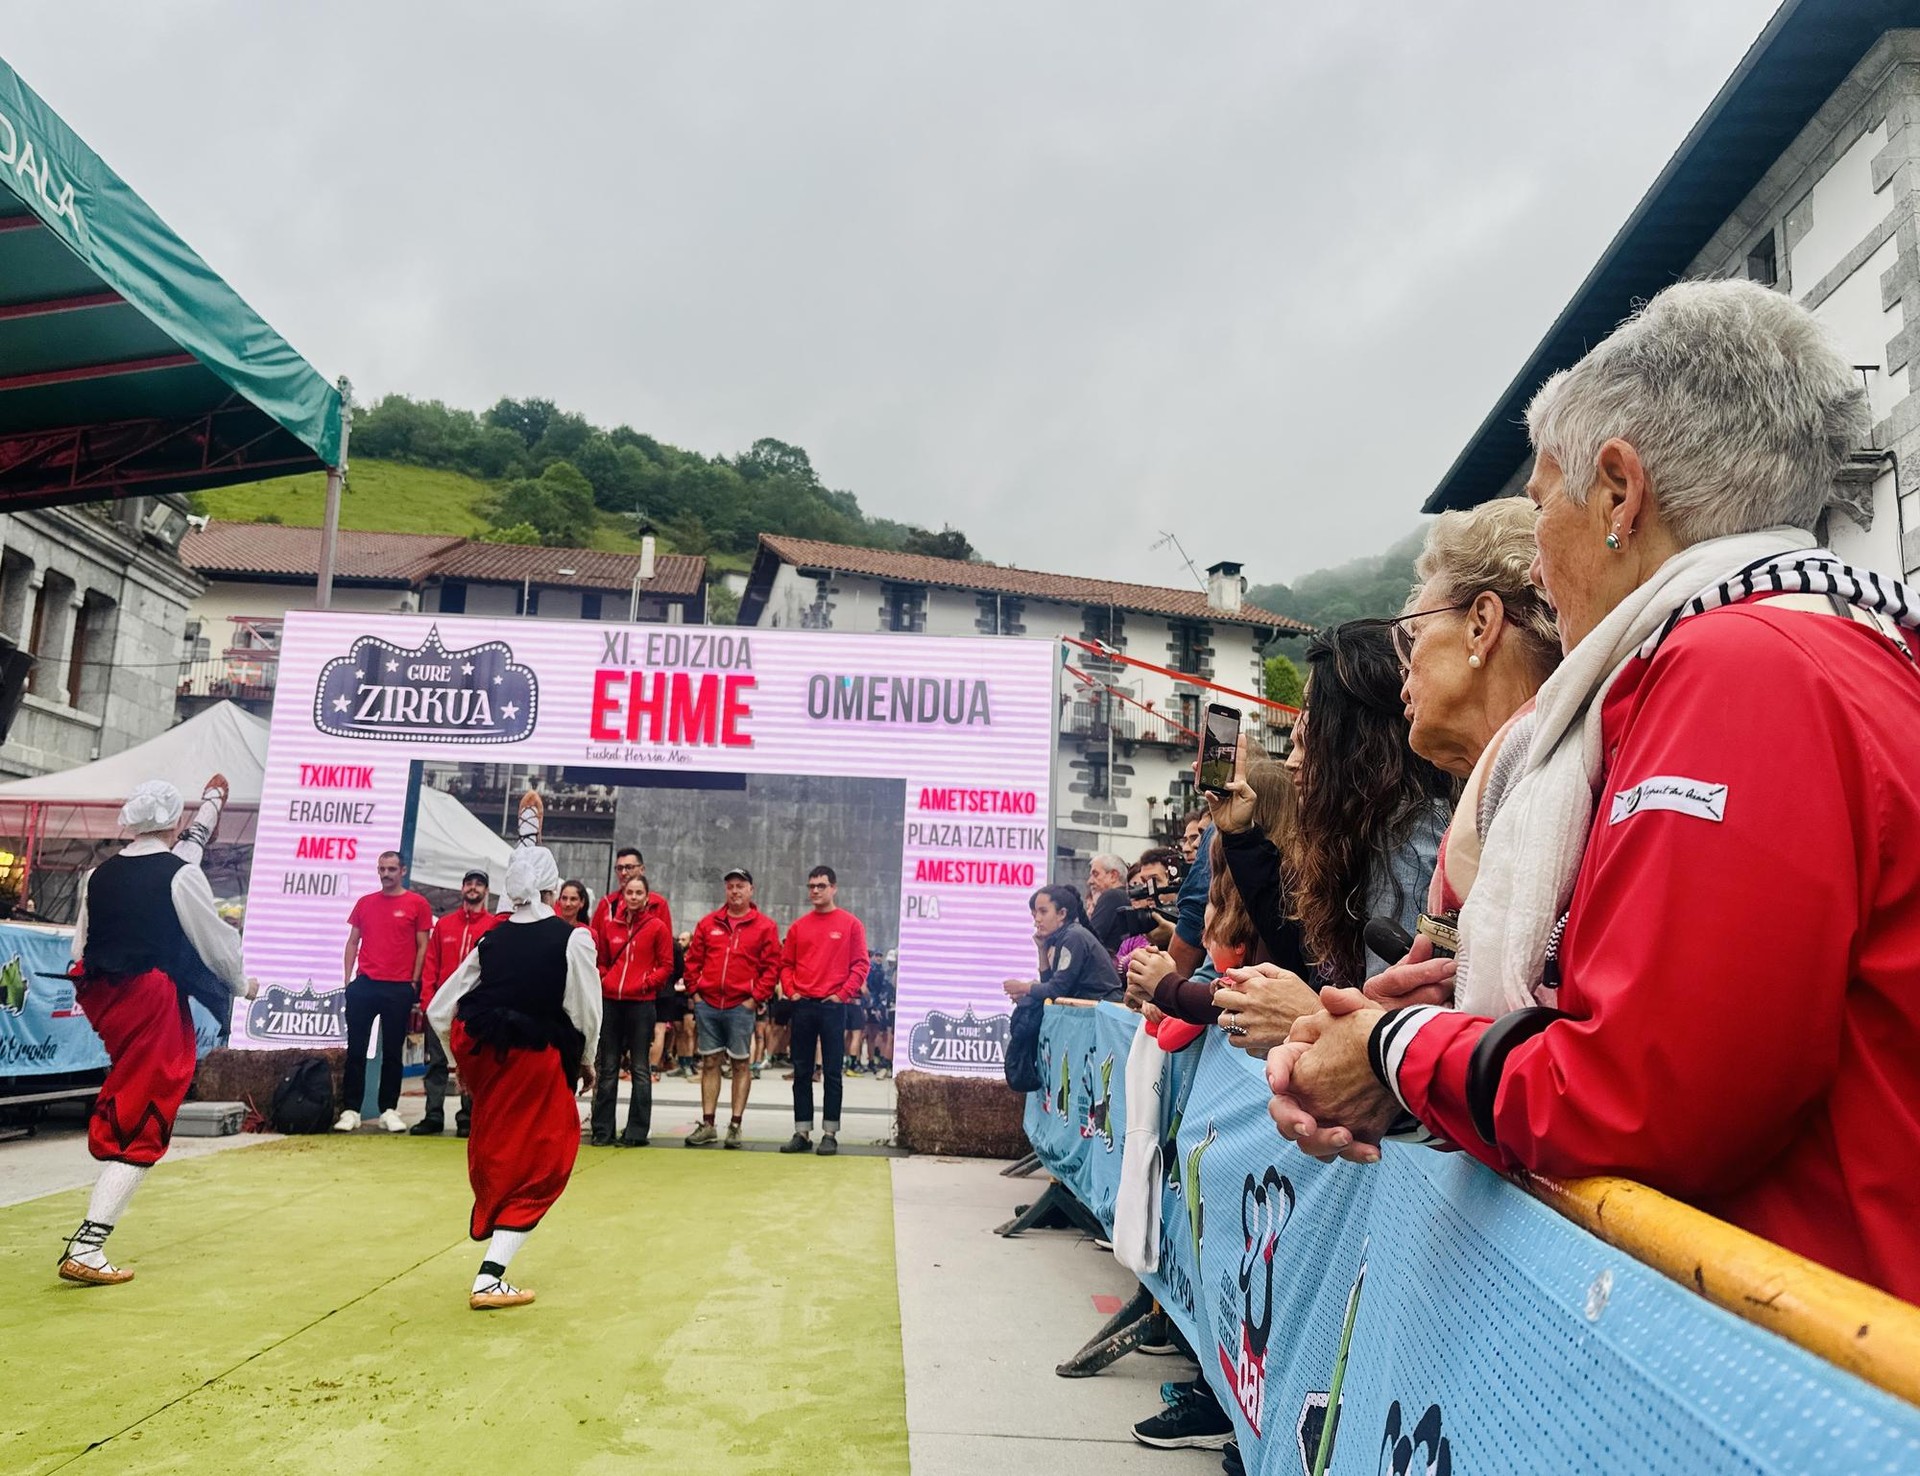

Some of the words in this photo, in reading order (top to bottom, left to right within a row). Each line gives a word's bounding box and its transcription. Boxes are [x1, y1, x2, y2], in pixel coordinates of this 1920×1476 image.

[601, 631, 636, 665] XI.
[646, 633, 752, 669] EDIZIOA
[407, 664, 452, 683] GURE
[353, 684, 495, 726] ZIRKUA
[590, 670, 758, 749] EHME
[807, 674, 991, 725] OMENDUA
[299, 764, 375, 789] TXIKITIK
[289, 800, 375, 825] ERAGINEZ
[919, 788, 1036, 814] AMETSETAKO
[296, 837, 358, 861] AMETS
[908, 823, 962, 847] PLAZA
[968, 826, 1045, 850] IZATETIK
[916, 860, 1034, 886] AMESTUTAKO
[267, 1011, 341, 1036] ZIRKUA
[930, 1038, 1005, 1062] ZIRKUA
